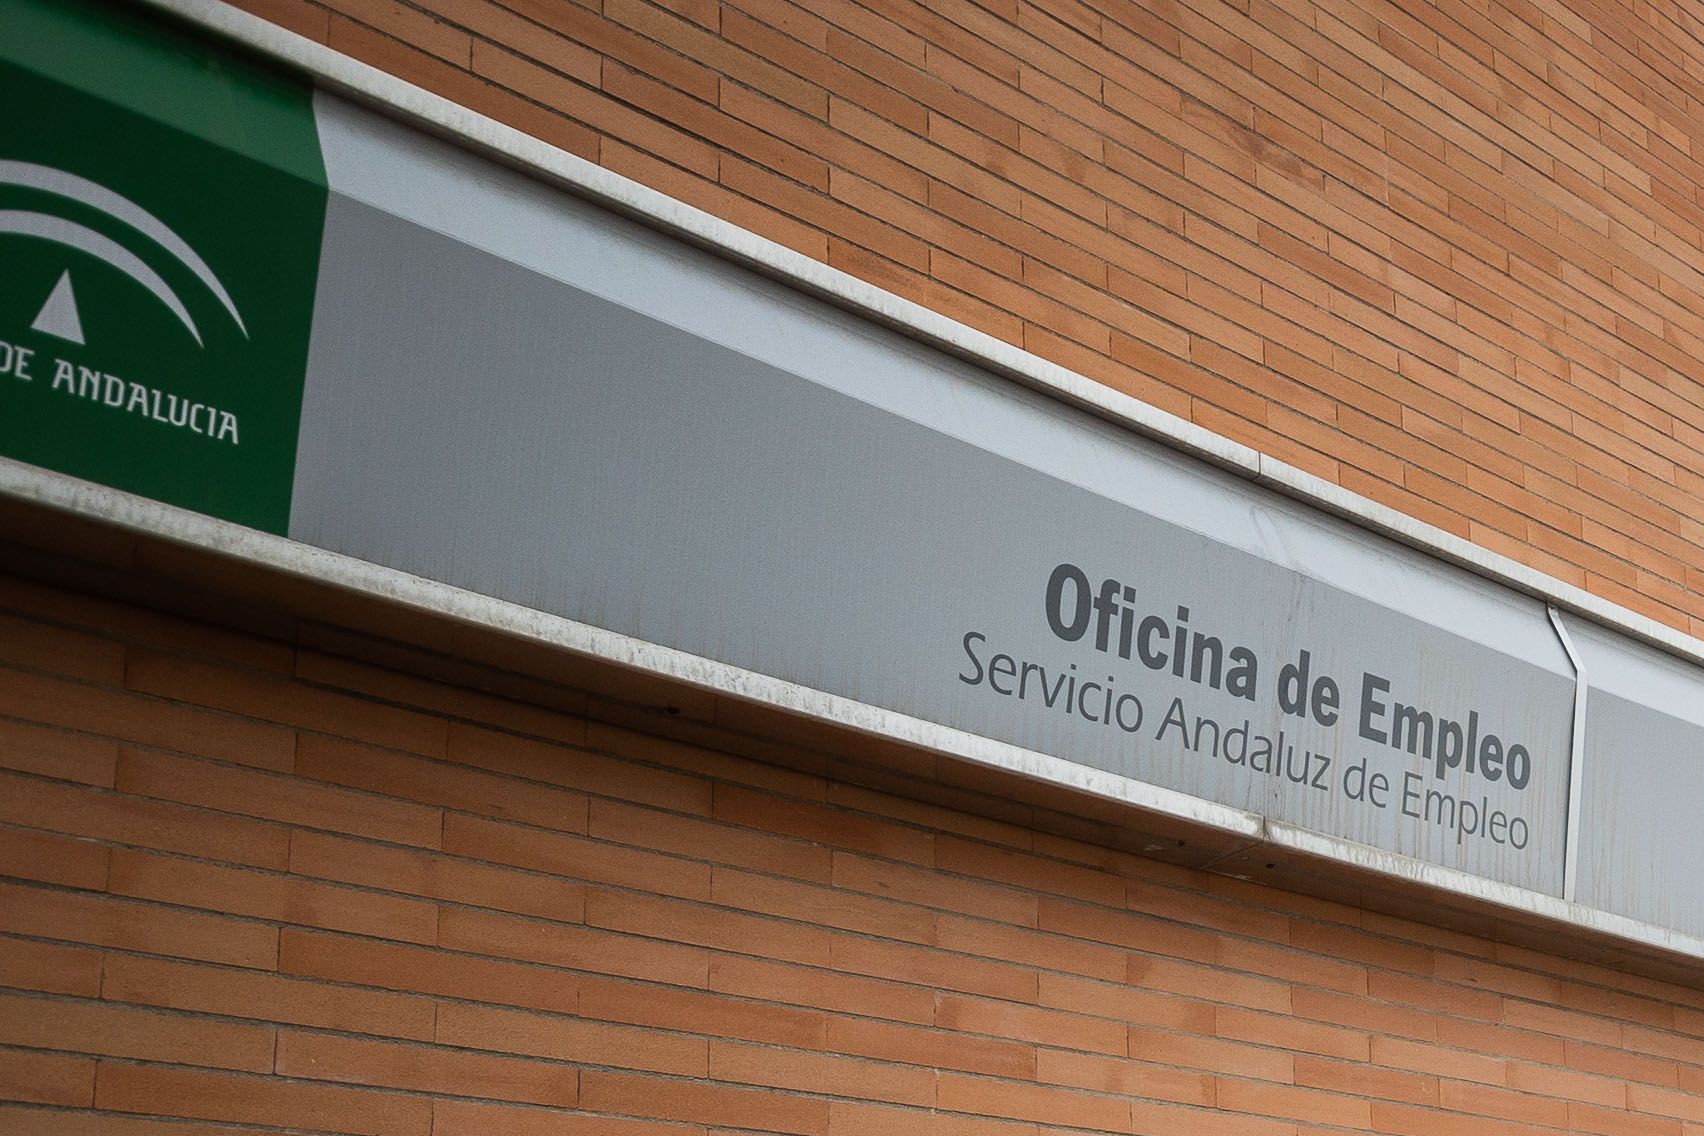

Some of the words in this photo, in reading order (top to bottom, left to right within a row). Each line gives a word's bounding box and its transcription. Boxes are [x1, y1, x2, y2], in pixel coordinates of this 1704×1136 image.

[0, 340, 35, 381] DE
[52, 358, 239, 445] ANDALUCIA
[958, 631, 1143, 733] Servicio
[1155, 698, 1332, 792] Andaluz
[1343, 757, 1389, 809] de
[1402, 772, 1529, 849] Empleo
[1045, 563, 1259, 702] Oficina
[1278, 649, 1340, 727] de
[1358, 672, 1531, 790] Empleo
